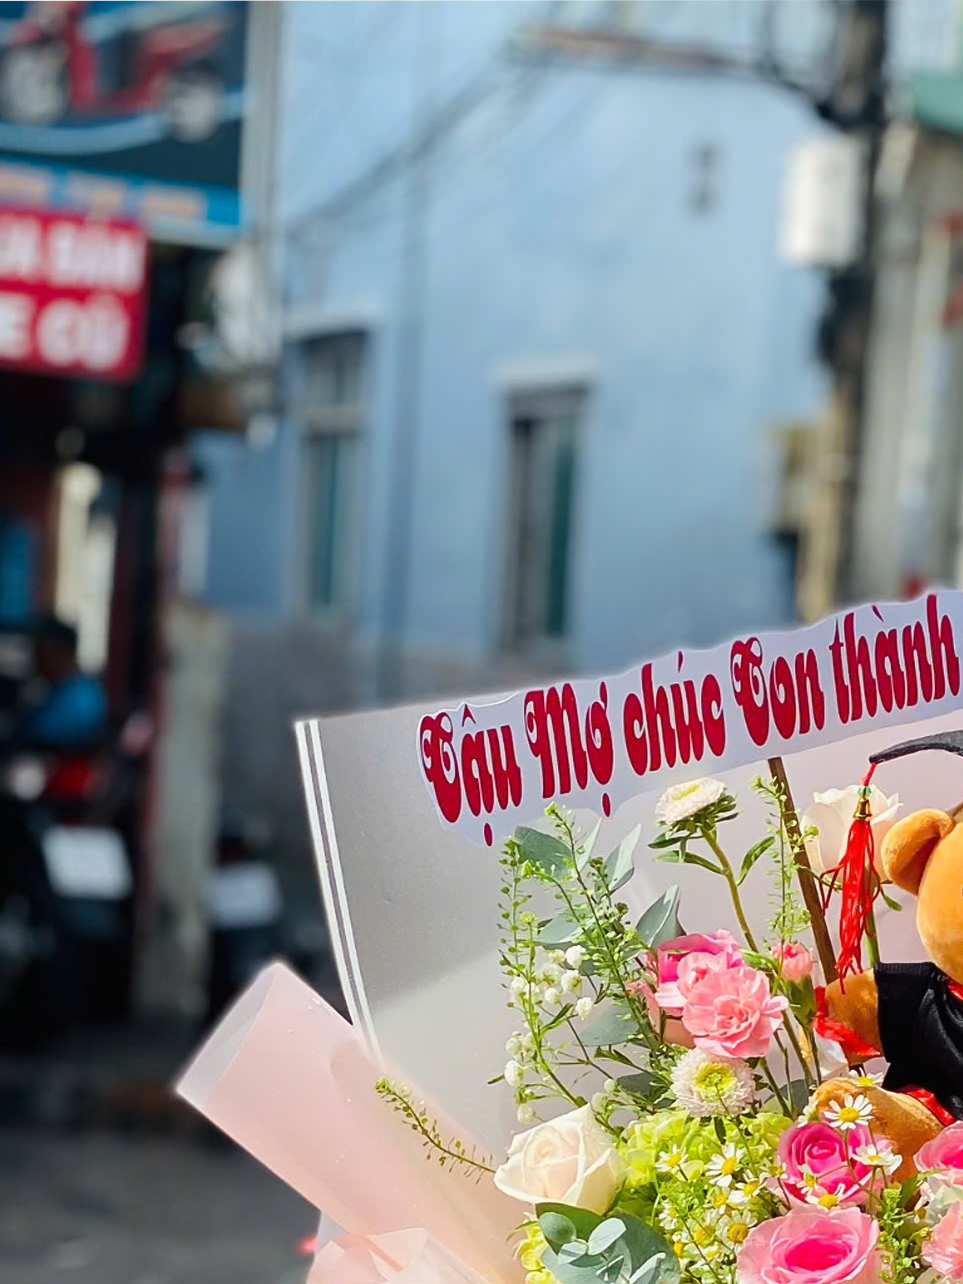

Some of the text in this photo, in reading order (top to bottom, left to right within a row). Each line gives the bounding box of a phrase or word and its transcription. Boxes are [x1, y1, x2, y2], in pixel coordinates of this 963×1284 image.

[420, 703, 523, 847] Cậu
[524, 680, 614, 818] Mợ
[623, 650, 727, 777] chúc
[730, 637, 825, 747] Con
[828, 594, 961, 723] thành
